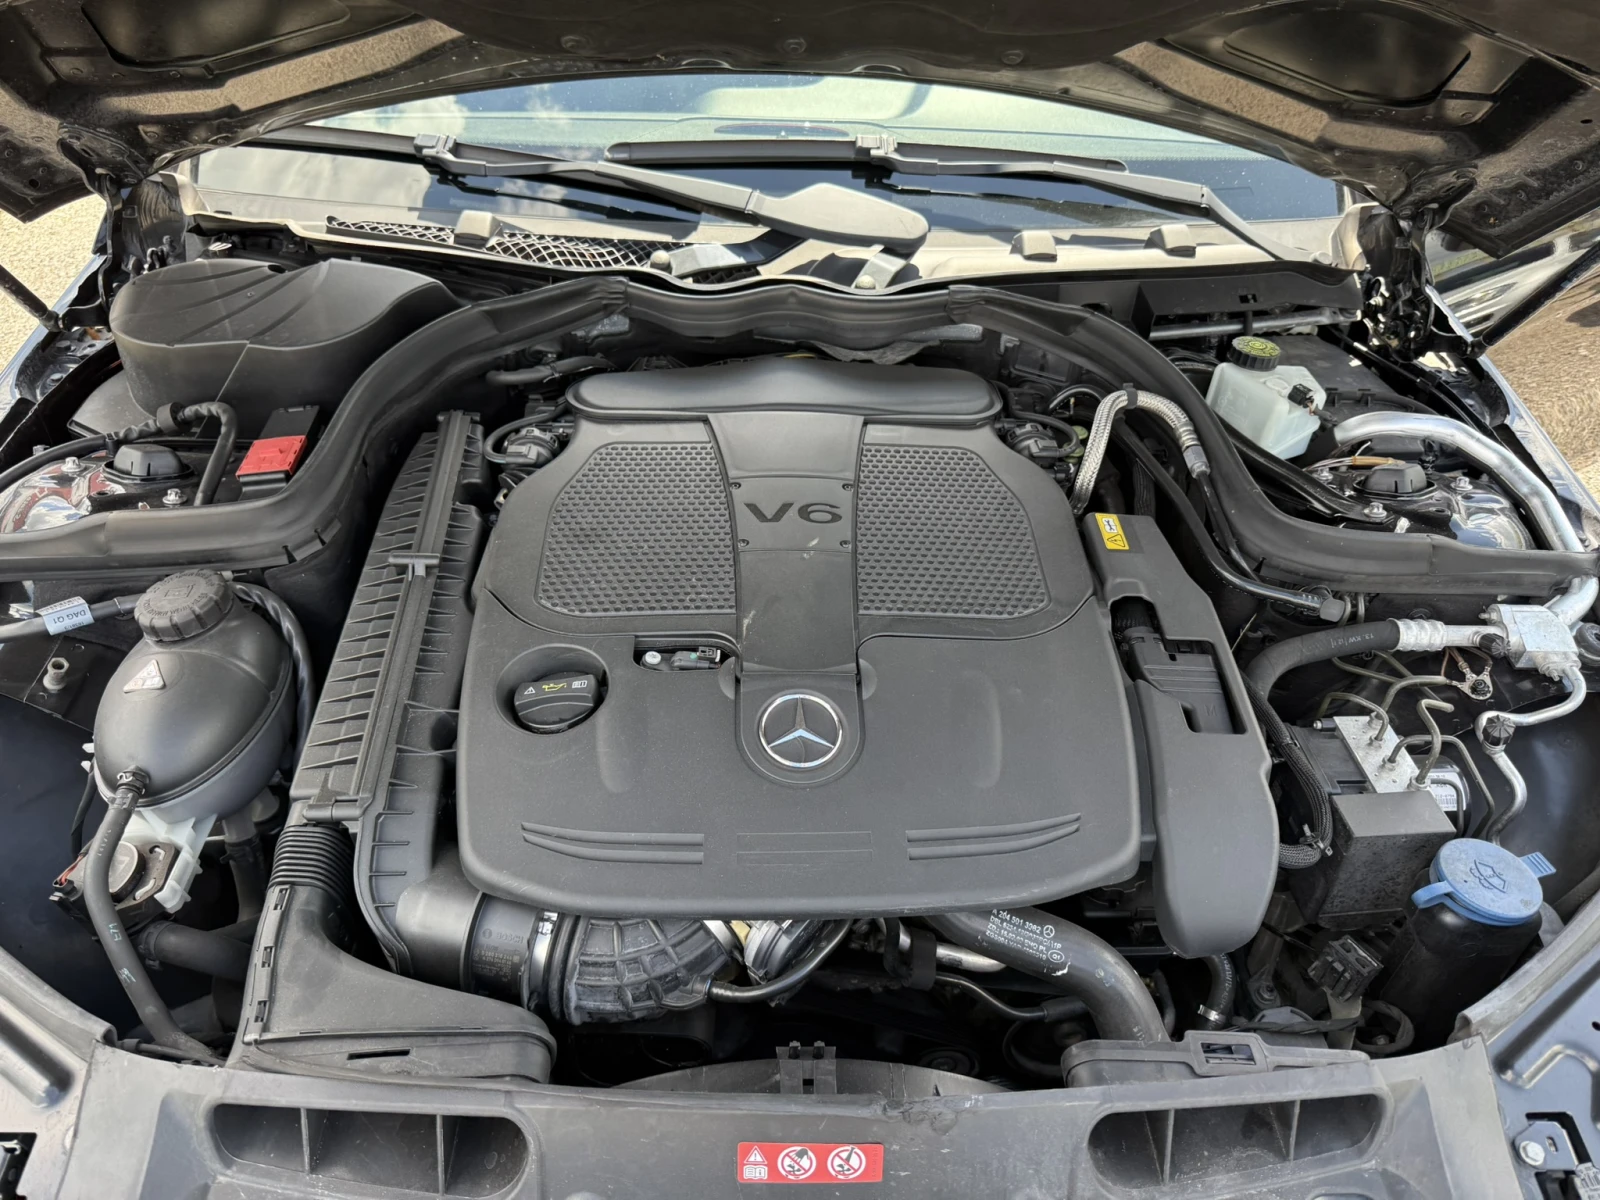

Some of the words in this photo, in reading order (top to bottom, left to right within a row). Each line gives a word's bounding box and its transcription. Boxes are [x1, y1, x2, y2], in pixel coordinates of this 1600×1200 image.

[744, 502, 842, 523] V6
[52, 615, 65, 624] Q1
[66, 609, 87, 621] DAG
[998, 910, 1011, 921] 204
[1011, 915, 1024, 927] 501
[496, 931, 524, 944] BOSCH
